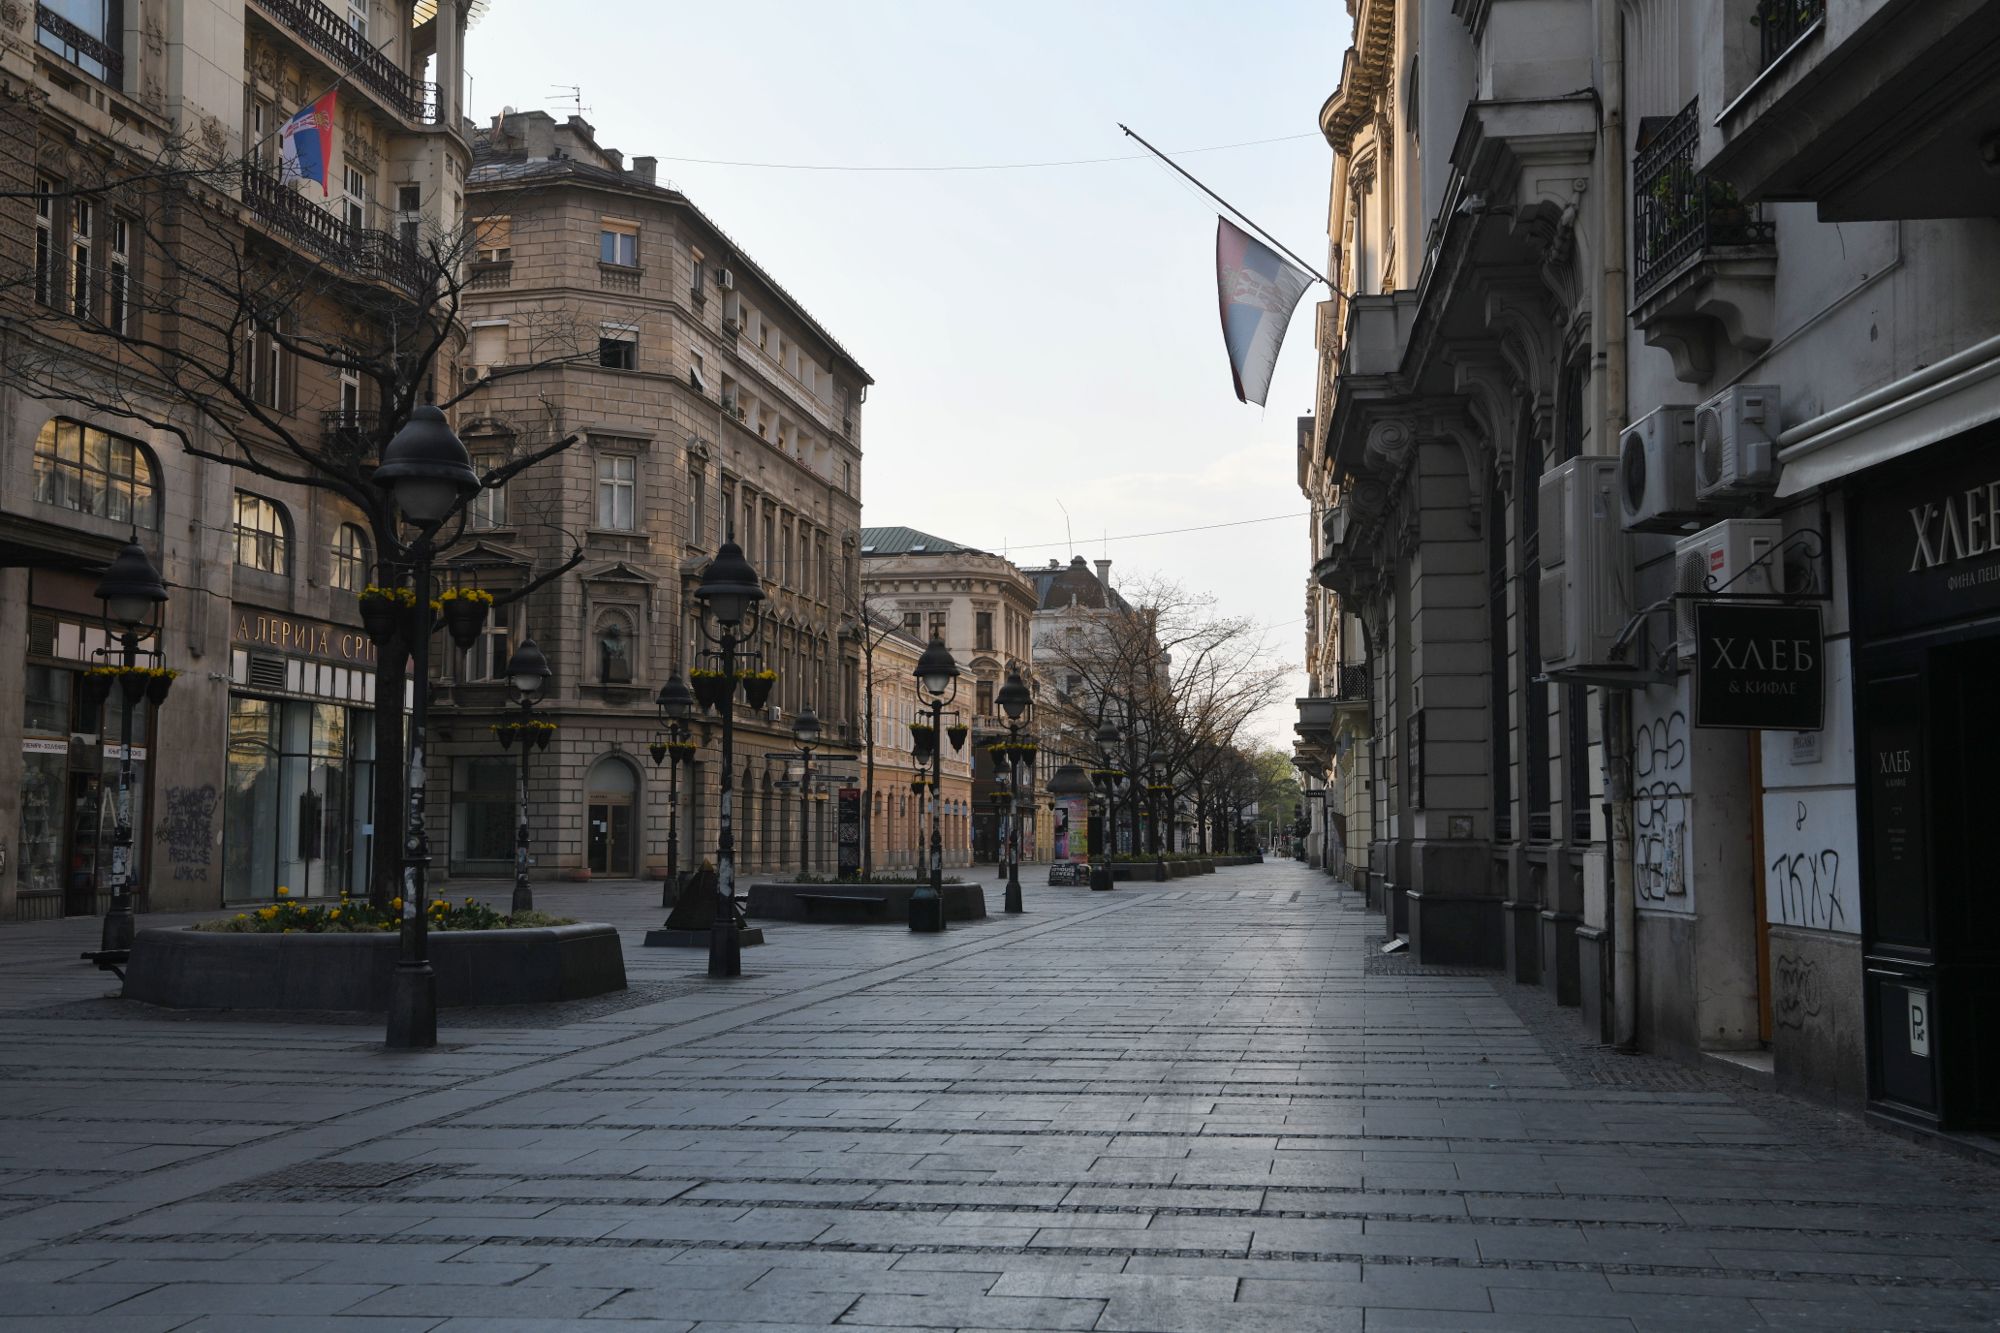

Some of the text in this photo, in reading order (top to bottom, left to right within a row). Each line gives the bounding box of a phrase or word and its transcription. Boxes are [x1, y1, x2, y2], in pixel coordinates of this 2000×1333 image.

[1947, 572, 1976, 591] ФИНА
[1711, 637, 1814, 672] ХЛЕБ
[1728, 680, 1799, 696] & КИФЛЕ
[1879, 750, 1911, 774] ХЛЕБ
